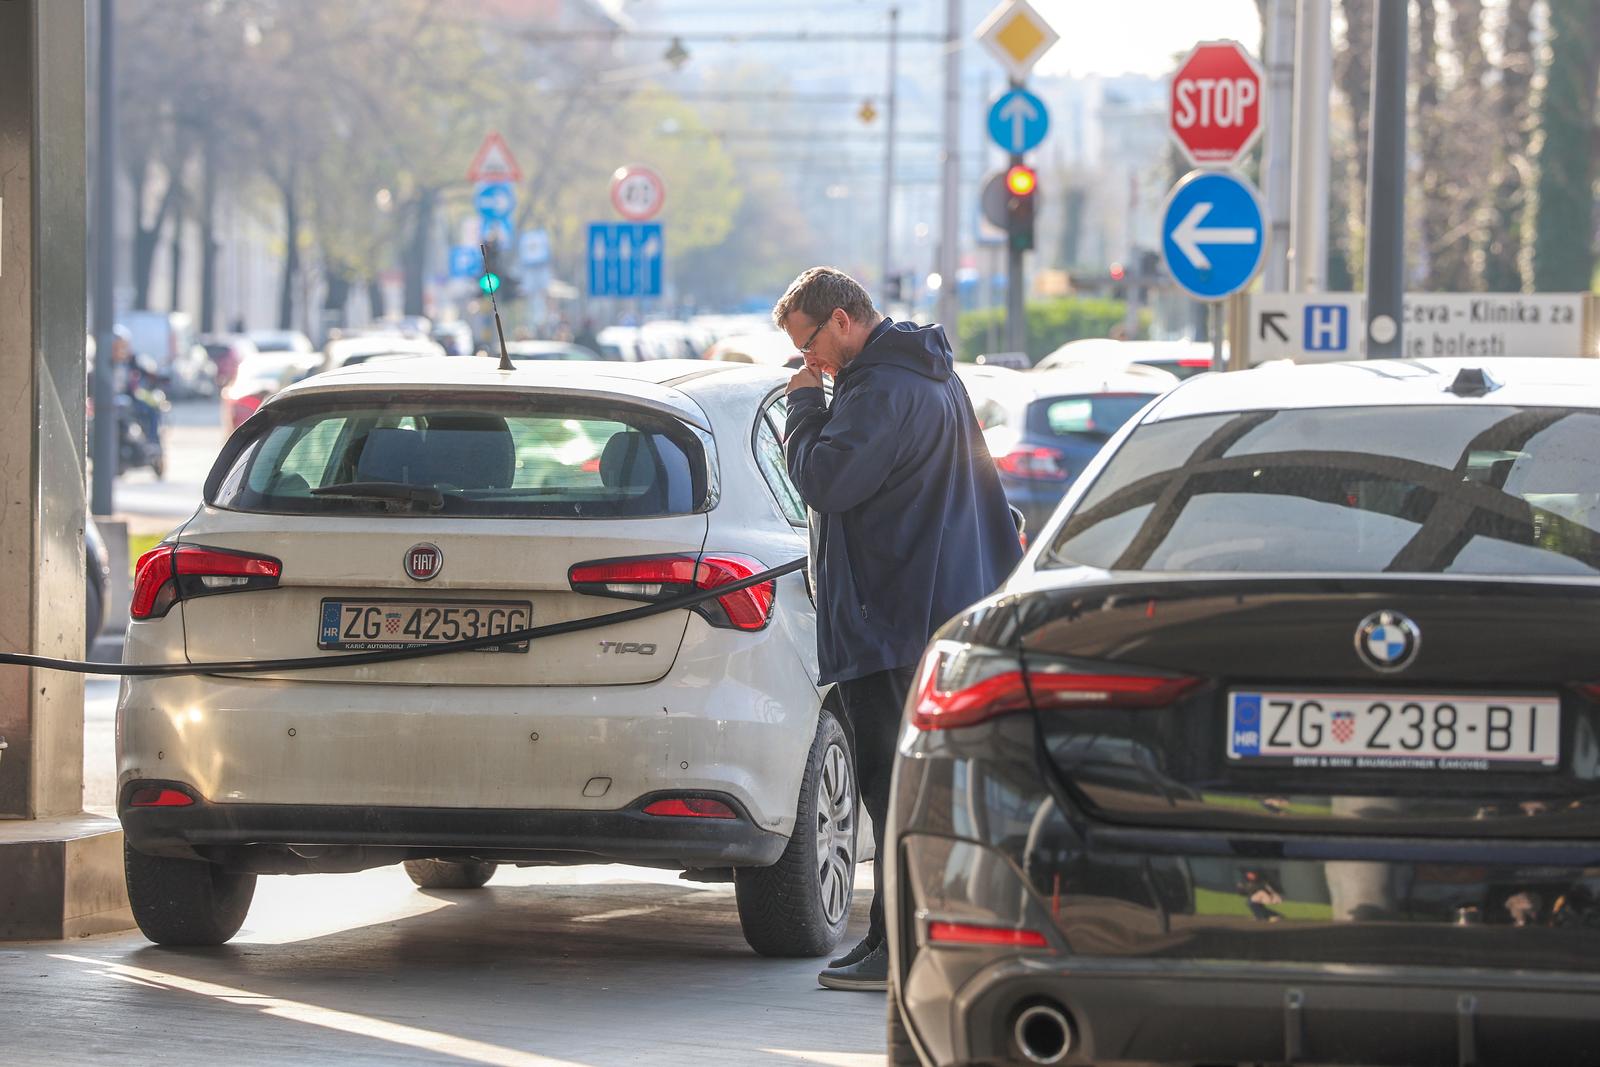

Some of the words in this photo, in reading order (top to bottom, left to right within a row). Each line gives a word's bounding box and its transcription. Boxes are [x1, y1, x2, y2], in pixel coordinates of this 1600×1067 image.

[1175, 77, 1256, 128] STOP
[1469, 300, 1541, 324] Klinika
[1550, 304, 1574, 324] za
[1311, 307, 1340, 349] H
[1432, 331, 1505, 355] bolesti
[413, 554, 435, 570] FIAT
[323, 627, 338, 637] HR
[343, 607, 382, 639] ZG
[599, 641, 657, 655] TIPO
[1267, 701, 1324, 748] ZG
[1234, 730, 1259, 747] HR
